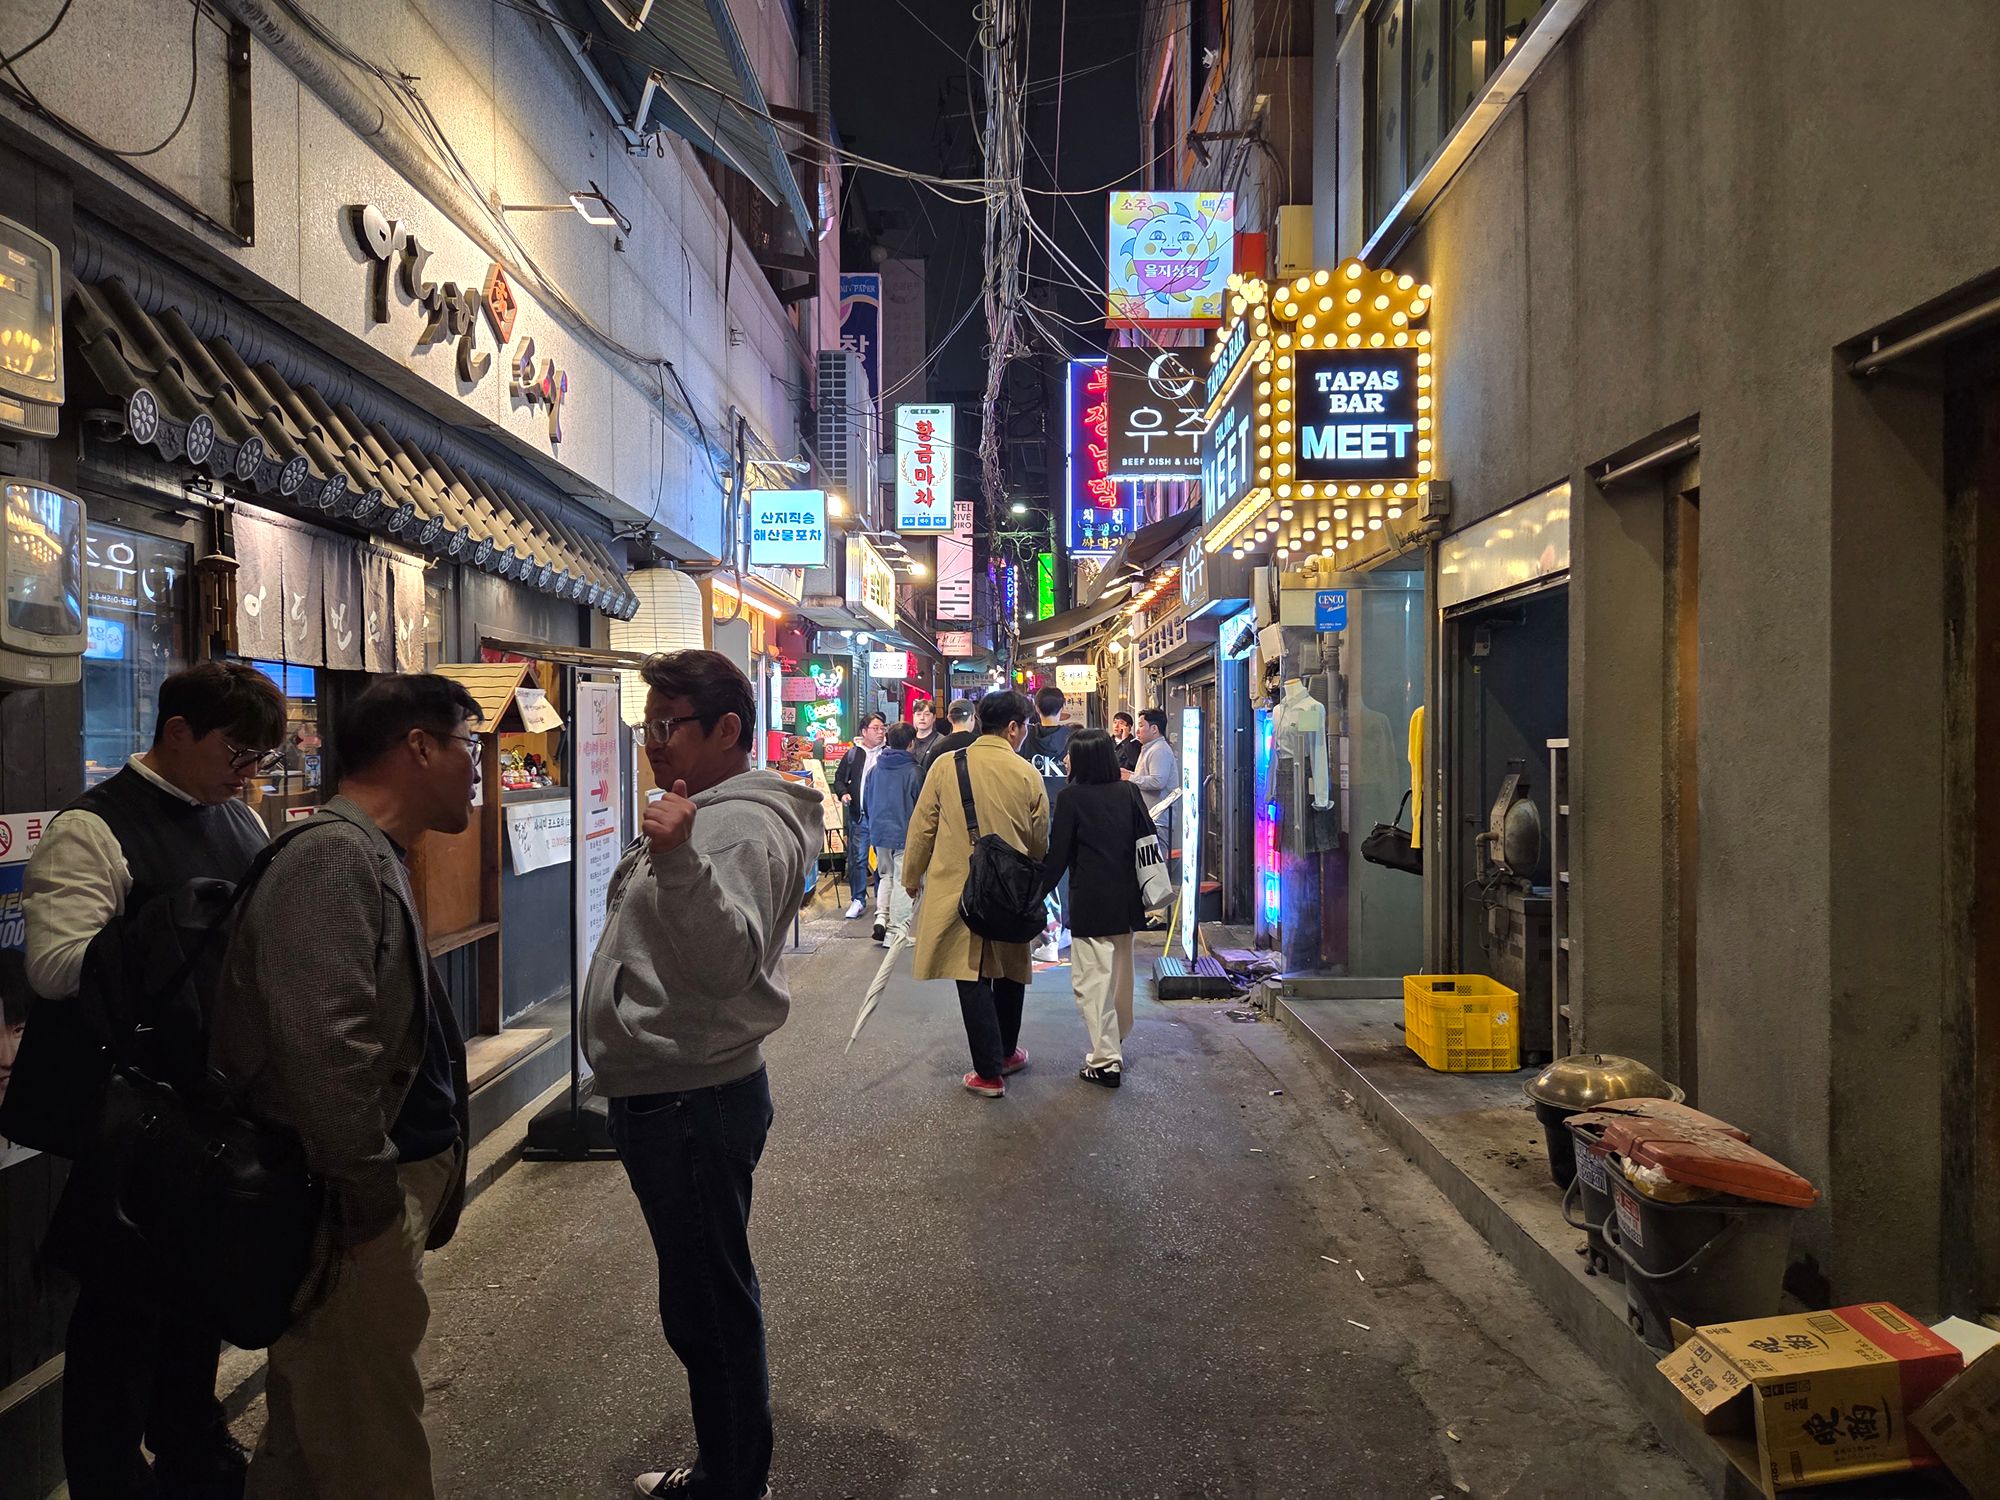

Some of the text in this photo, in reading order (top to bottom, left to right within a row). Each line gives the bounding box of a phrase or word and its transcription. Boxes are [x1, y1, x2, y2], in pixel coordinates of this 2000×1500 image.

[1120, 199, 1147, 211] 소주
[1144, 264, 1199, 278] 을지상회
[1315, 371, 1399, 392] TAPAS
[1329, 393, 1384, 414] BAR
[1125, 406, 1204, 453] 우주
[1302, 424, 1413, 460] MEET
[914, 420, 935, 508] 황금마차
[1122, 458, 1145, 466] BEEF
[1149, 458, 1171, 466] DISH
[1175, 458, 1180, 466] &
[1205, 415, 1250, 523] MEET
[954, 503, 972, 511] TEL
[761, 512, 815, 524] 산지직송
[753, 529, 822, 541] 해산물포차
[1318, 594, 1344, 604] CESCO
[27, 819, 42, 840] 금
[1137, 843, 1164, 868] NIK
[1721, 1370, 1743, 1389] 7483
